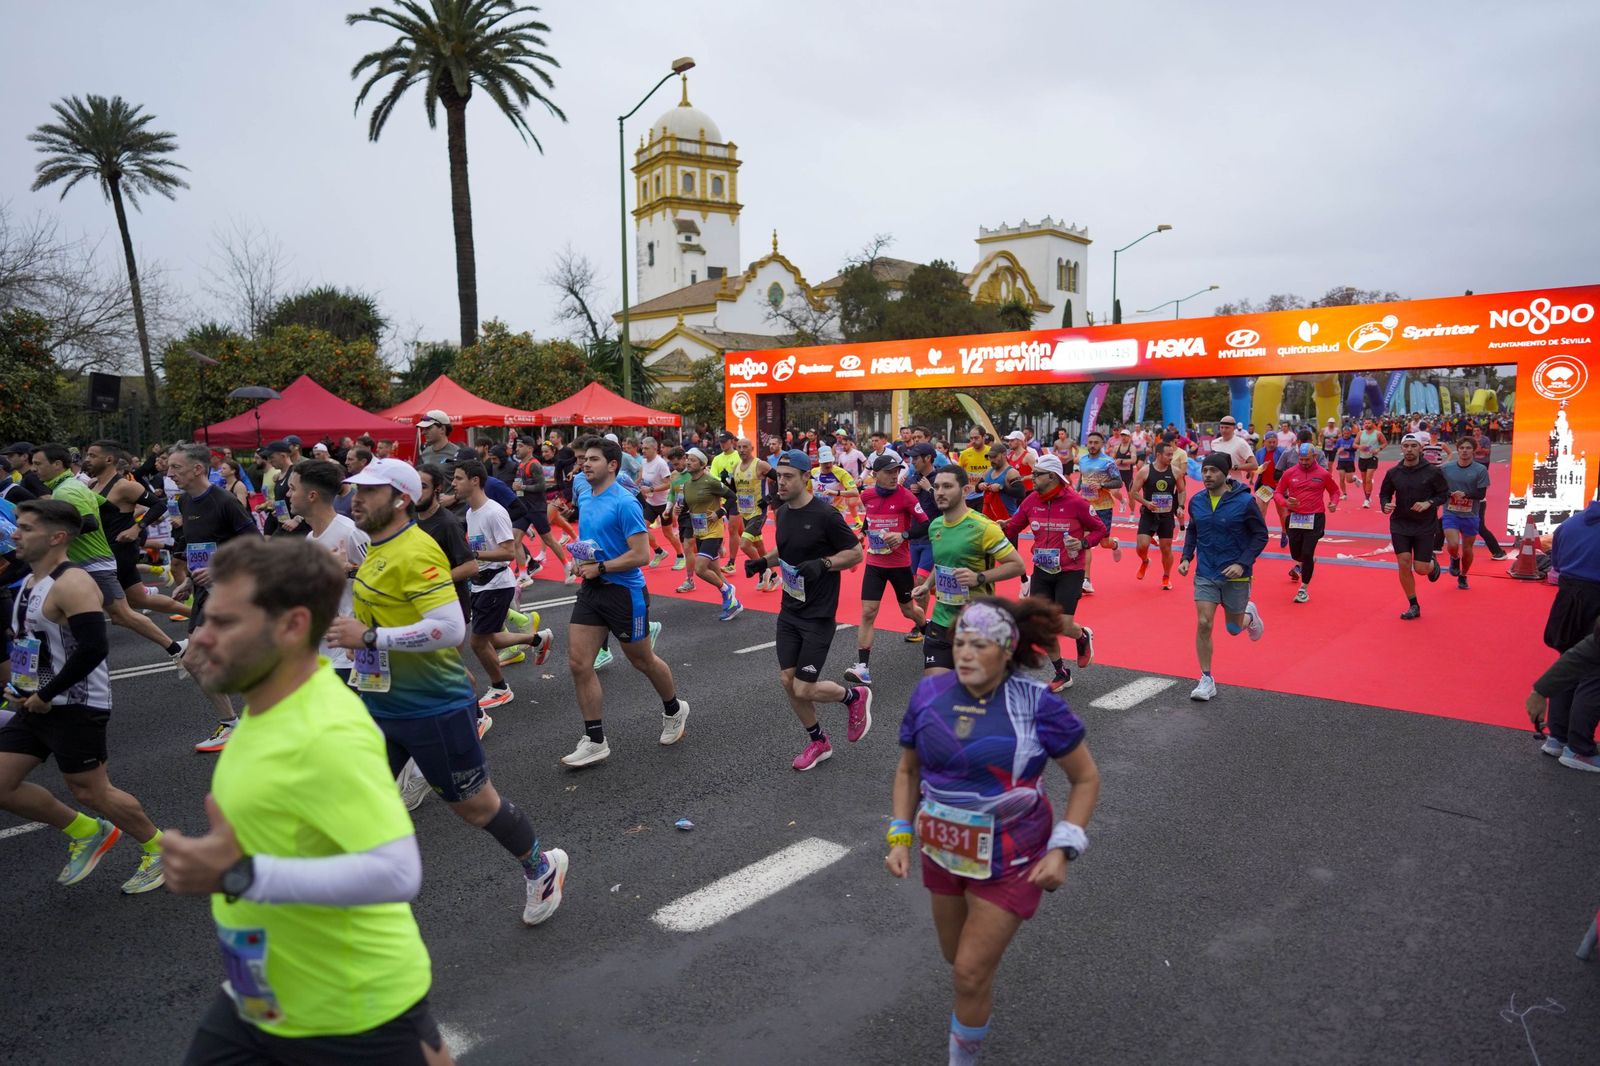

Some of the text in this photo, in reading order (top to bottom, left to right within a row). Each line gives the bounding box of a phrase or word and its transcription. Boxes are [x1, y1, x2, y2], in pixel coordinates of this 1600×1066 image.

[1401, 324, 1480, 340] Sprinter
[978, 340, 1051, 360] maratón
[1145, 337, 1208, 360] HOKA
[1218, 348, 1266, 359] HYUNDAI
[870, 357, 913, 374] HOKA
[995, 356, 1052, 373] sevilla
[190, 551, 208, 562] 2950
[938, 575, 958, 588] 2783
[953, 705, 987, 715] marathon
[927, 819, 970, 850] 1331
